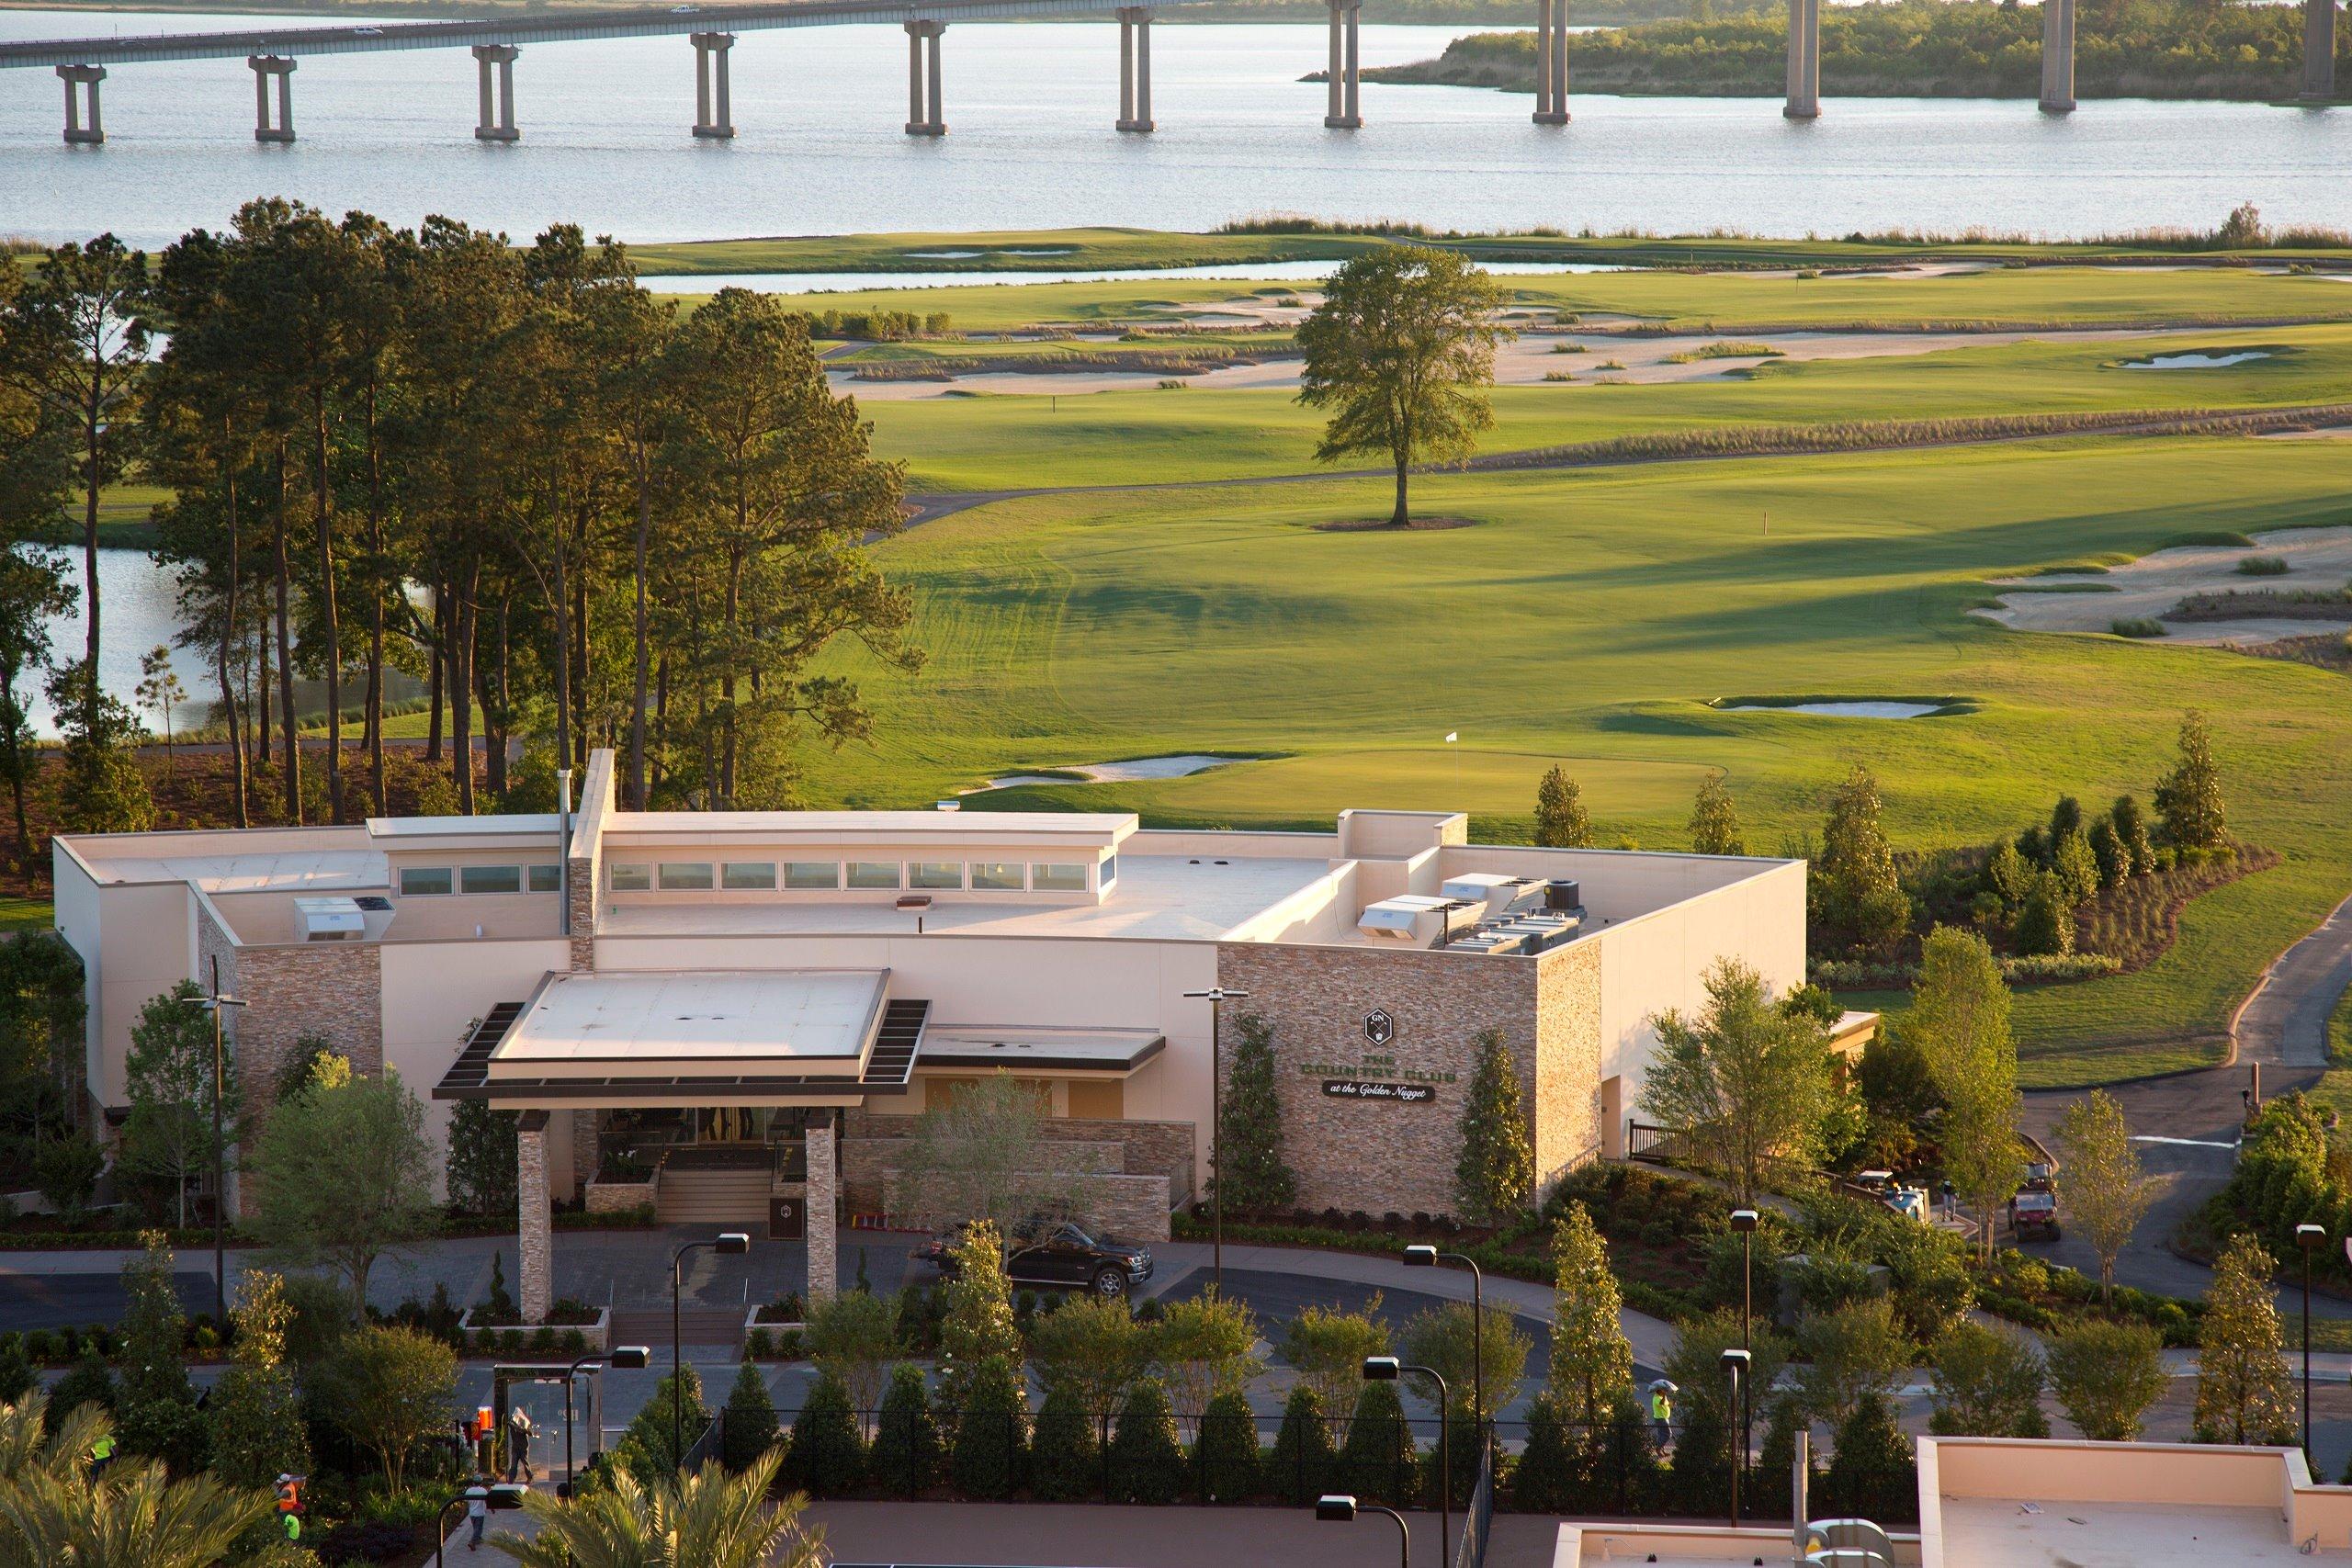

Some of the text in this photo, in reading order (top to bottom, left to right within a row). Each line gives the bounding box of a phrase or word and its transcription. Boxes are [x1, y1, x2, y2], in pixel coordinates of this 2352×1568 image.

[1362, 1055, 1395, 1065] THE
[1300, 1064, 1456, 1082] COUNTRY CLUB
[1330, 1083, 1427, 1100] at the Golden Nugget
